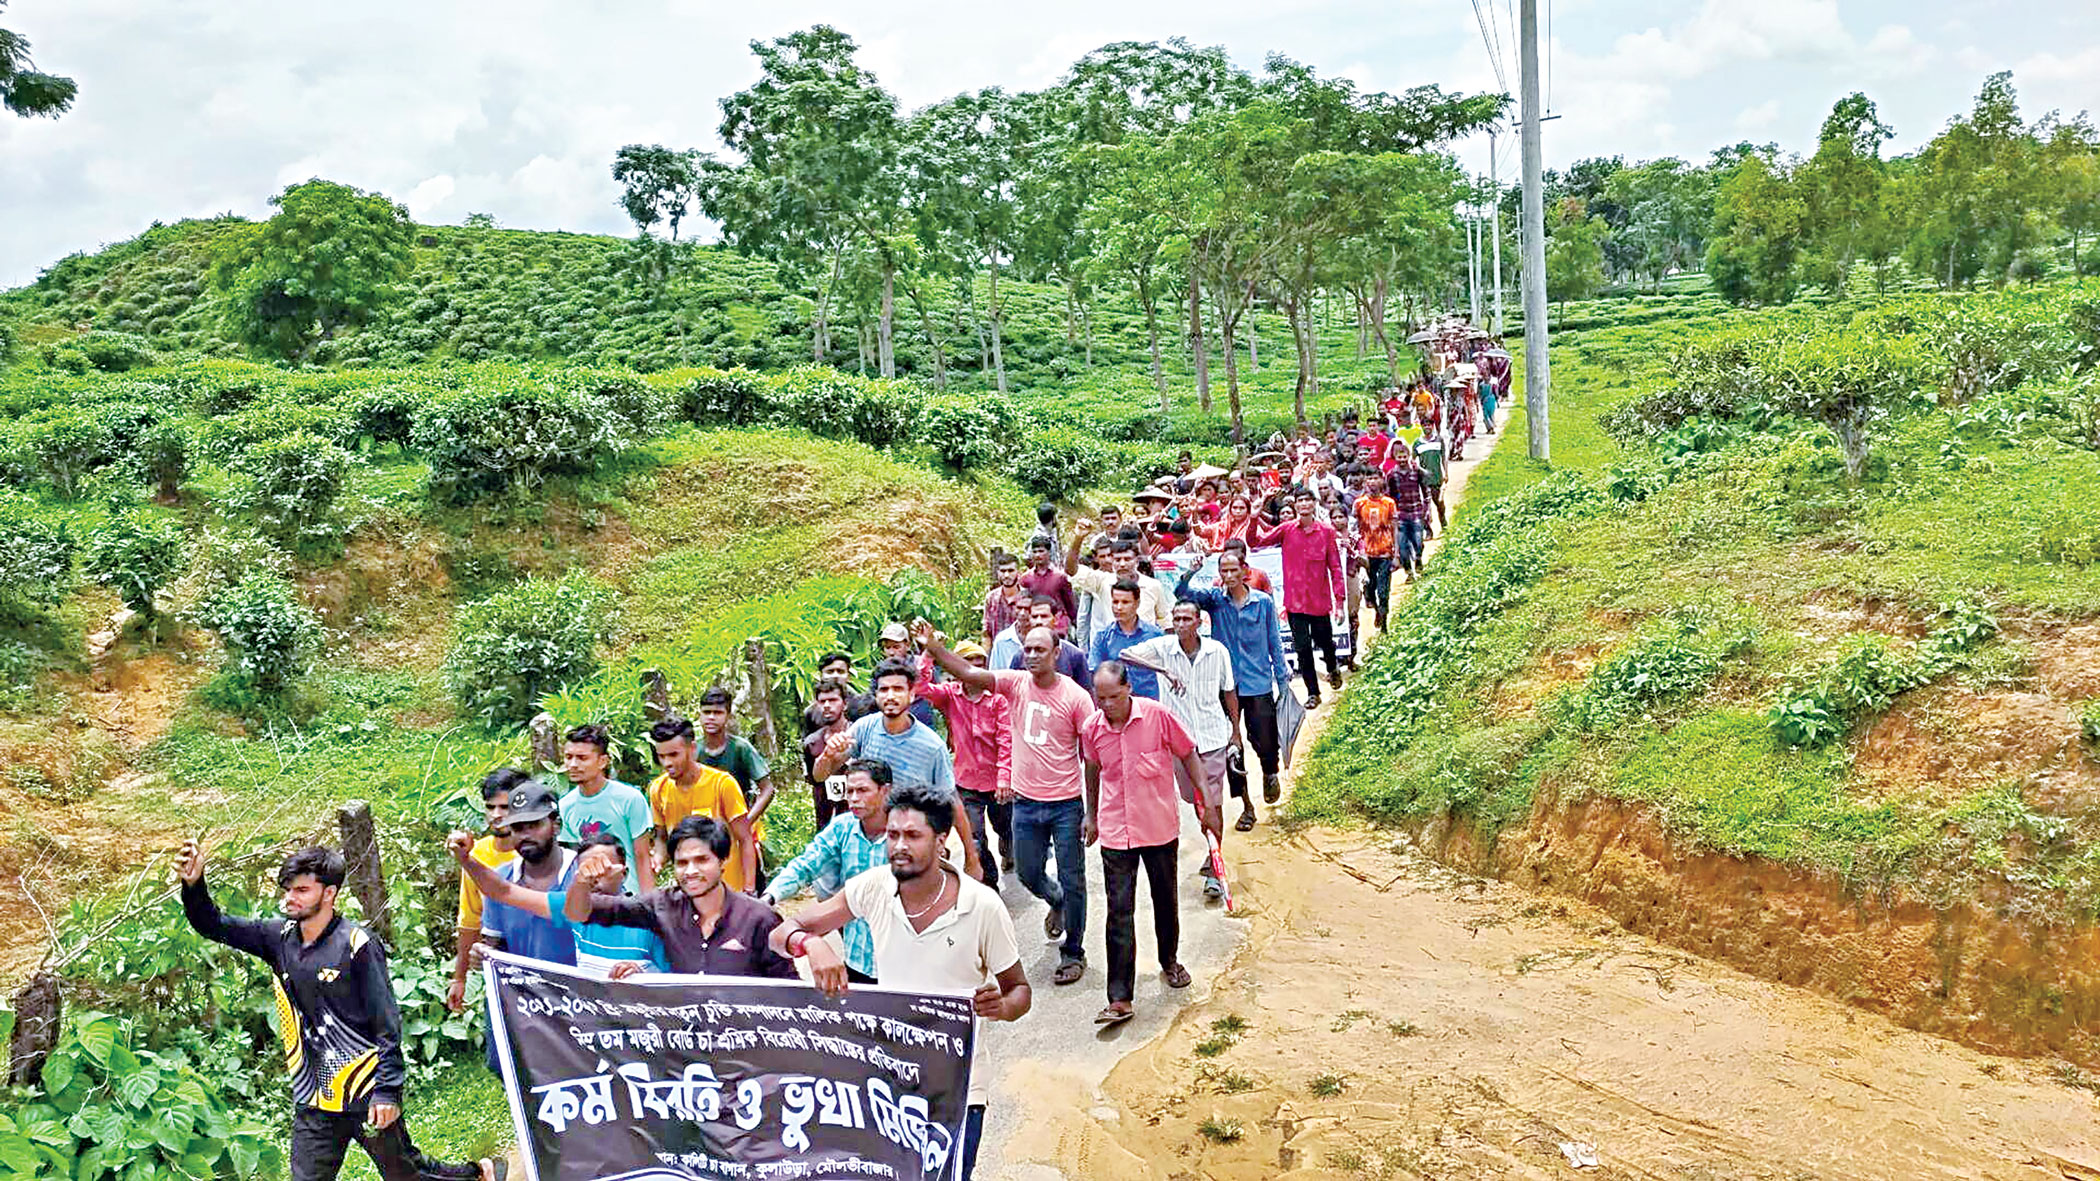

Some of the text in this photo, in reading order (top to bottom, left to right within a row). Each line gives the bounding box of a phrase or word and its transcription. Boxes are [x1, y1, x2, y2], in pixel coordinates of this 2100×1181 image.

[1023, 701, 1051, 745] C
[667, 1023, 696, 1051] বোর্ড
[695, 1029, 714, 1053] চা
[715, 1027, 758, 1052] শ্রমিক
[756, 1025, 809, 1050] বিরোধী
[794, 1004, 842, 1024] মালিক
[951, 1036, 964, 1058] ও
[530, 1058, 617, 1134] কর্ম
[733, 1077, 763, 1131] ও
